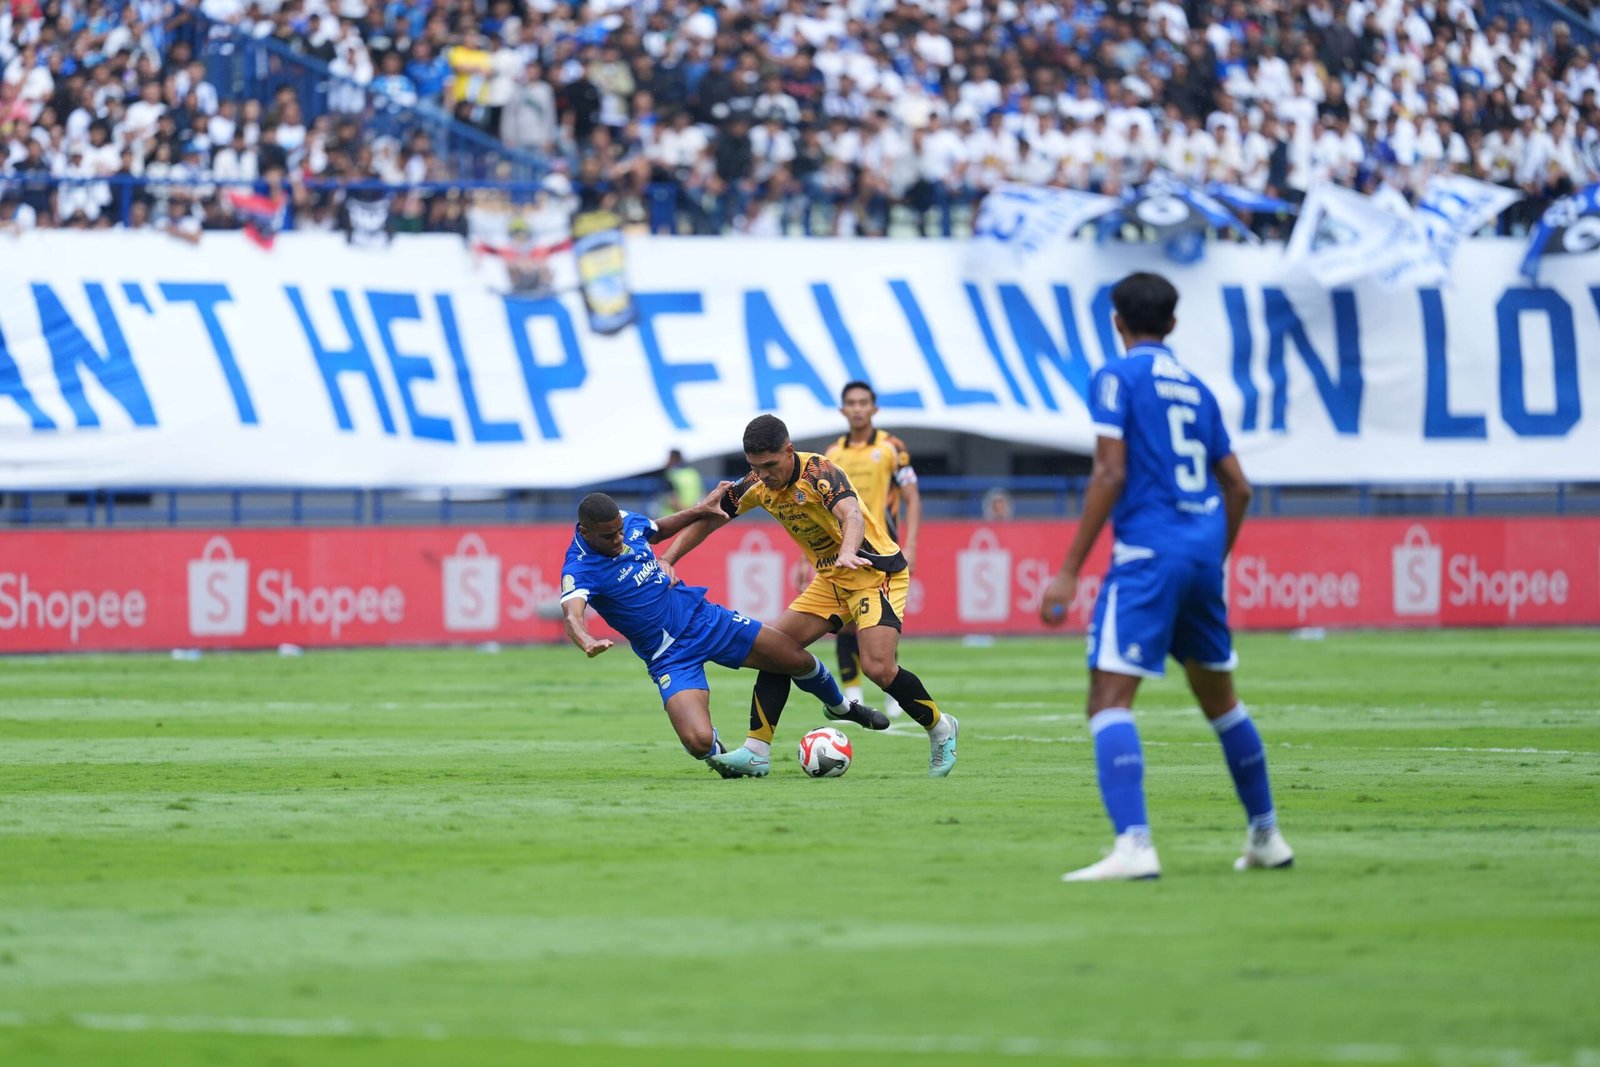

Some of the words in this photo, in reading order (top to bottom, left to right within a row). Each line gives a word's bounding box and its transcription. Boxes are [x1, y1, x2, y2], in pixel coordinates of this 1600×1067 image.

[282, 284, 588, 444] HELP
[1221, 285, 1364, 435] IN
[1418, 285, 1600, 440] LO
[1166, 403, 1208, 493] 5
[0, 571, 147, 644] Shopee
[257, 567, 406, 640] Shopee
[1235, 555, 1361, 622] Shopee
[1448, 553, 1569, 620] Shopee
